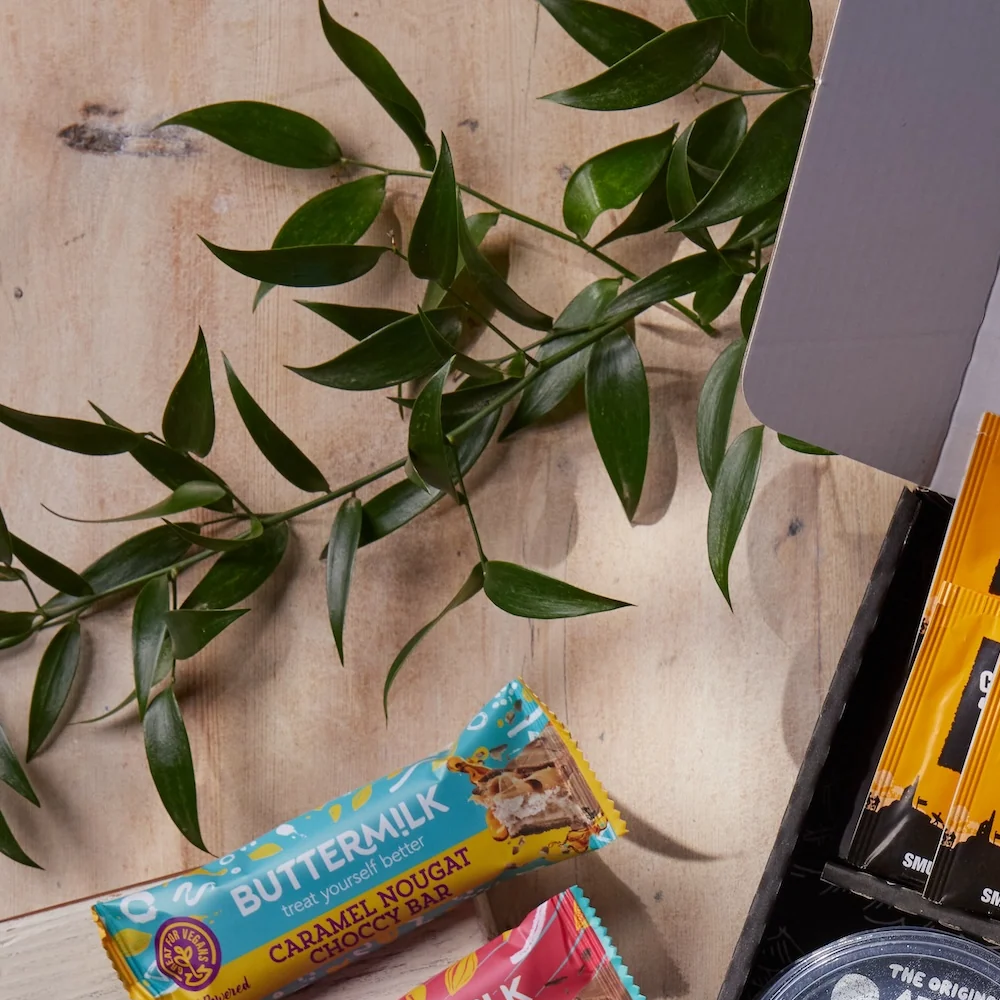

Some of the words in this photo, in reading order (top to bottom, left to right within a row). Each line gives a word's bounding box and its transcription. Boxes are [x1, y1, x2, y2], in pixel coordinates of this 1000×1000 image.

[269, 900, 378, 963] CARAMEL
[376, 847, 472, 908] NOUGAT
[281, 895, 322, 918] treat
[320, 860, 378, 905] yourself
[379, 836, 425, 868] better
[165, 929, 180, 947] FOR
[182, 928, 209, 962] VEGANS
[310, 908, 401, 964] CHOCCY
[405, 884, 453, 917] BAR
[889, 963, 926, 988] THE
